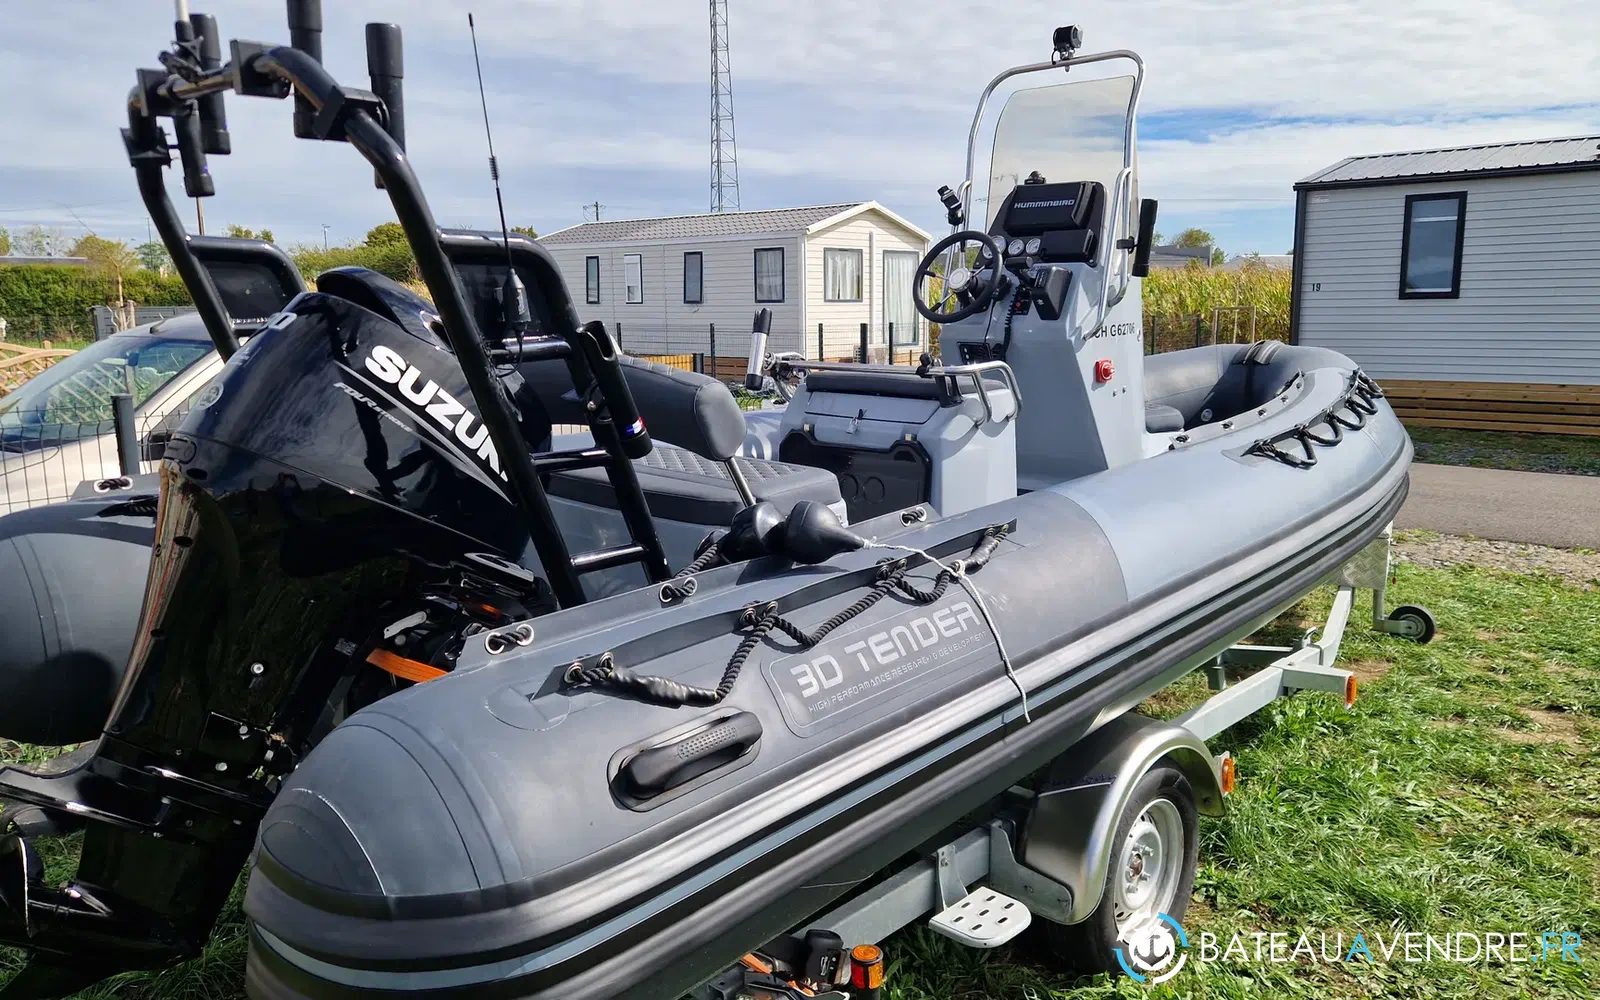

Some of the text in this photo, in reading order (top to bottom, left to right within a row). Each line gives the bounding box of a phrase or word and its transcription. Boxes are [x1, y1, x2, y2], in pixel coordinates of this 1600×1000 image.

[1014, 199, 1076, 210] HUMMINBIRD
[1312, 282, 1321, 292] 19
[364, 345, 509, 483] SUZUK
[790, 601, 981, 698] 3D TENDER
[808, 698, 832, 714] HIGH
[831, 671, 892, 704] PERFORMANCE
[892, 655, 932, 678] RESEARCH
[939, 631, 987, 657] DEVELOPMENT
